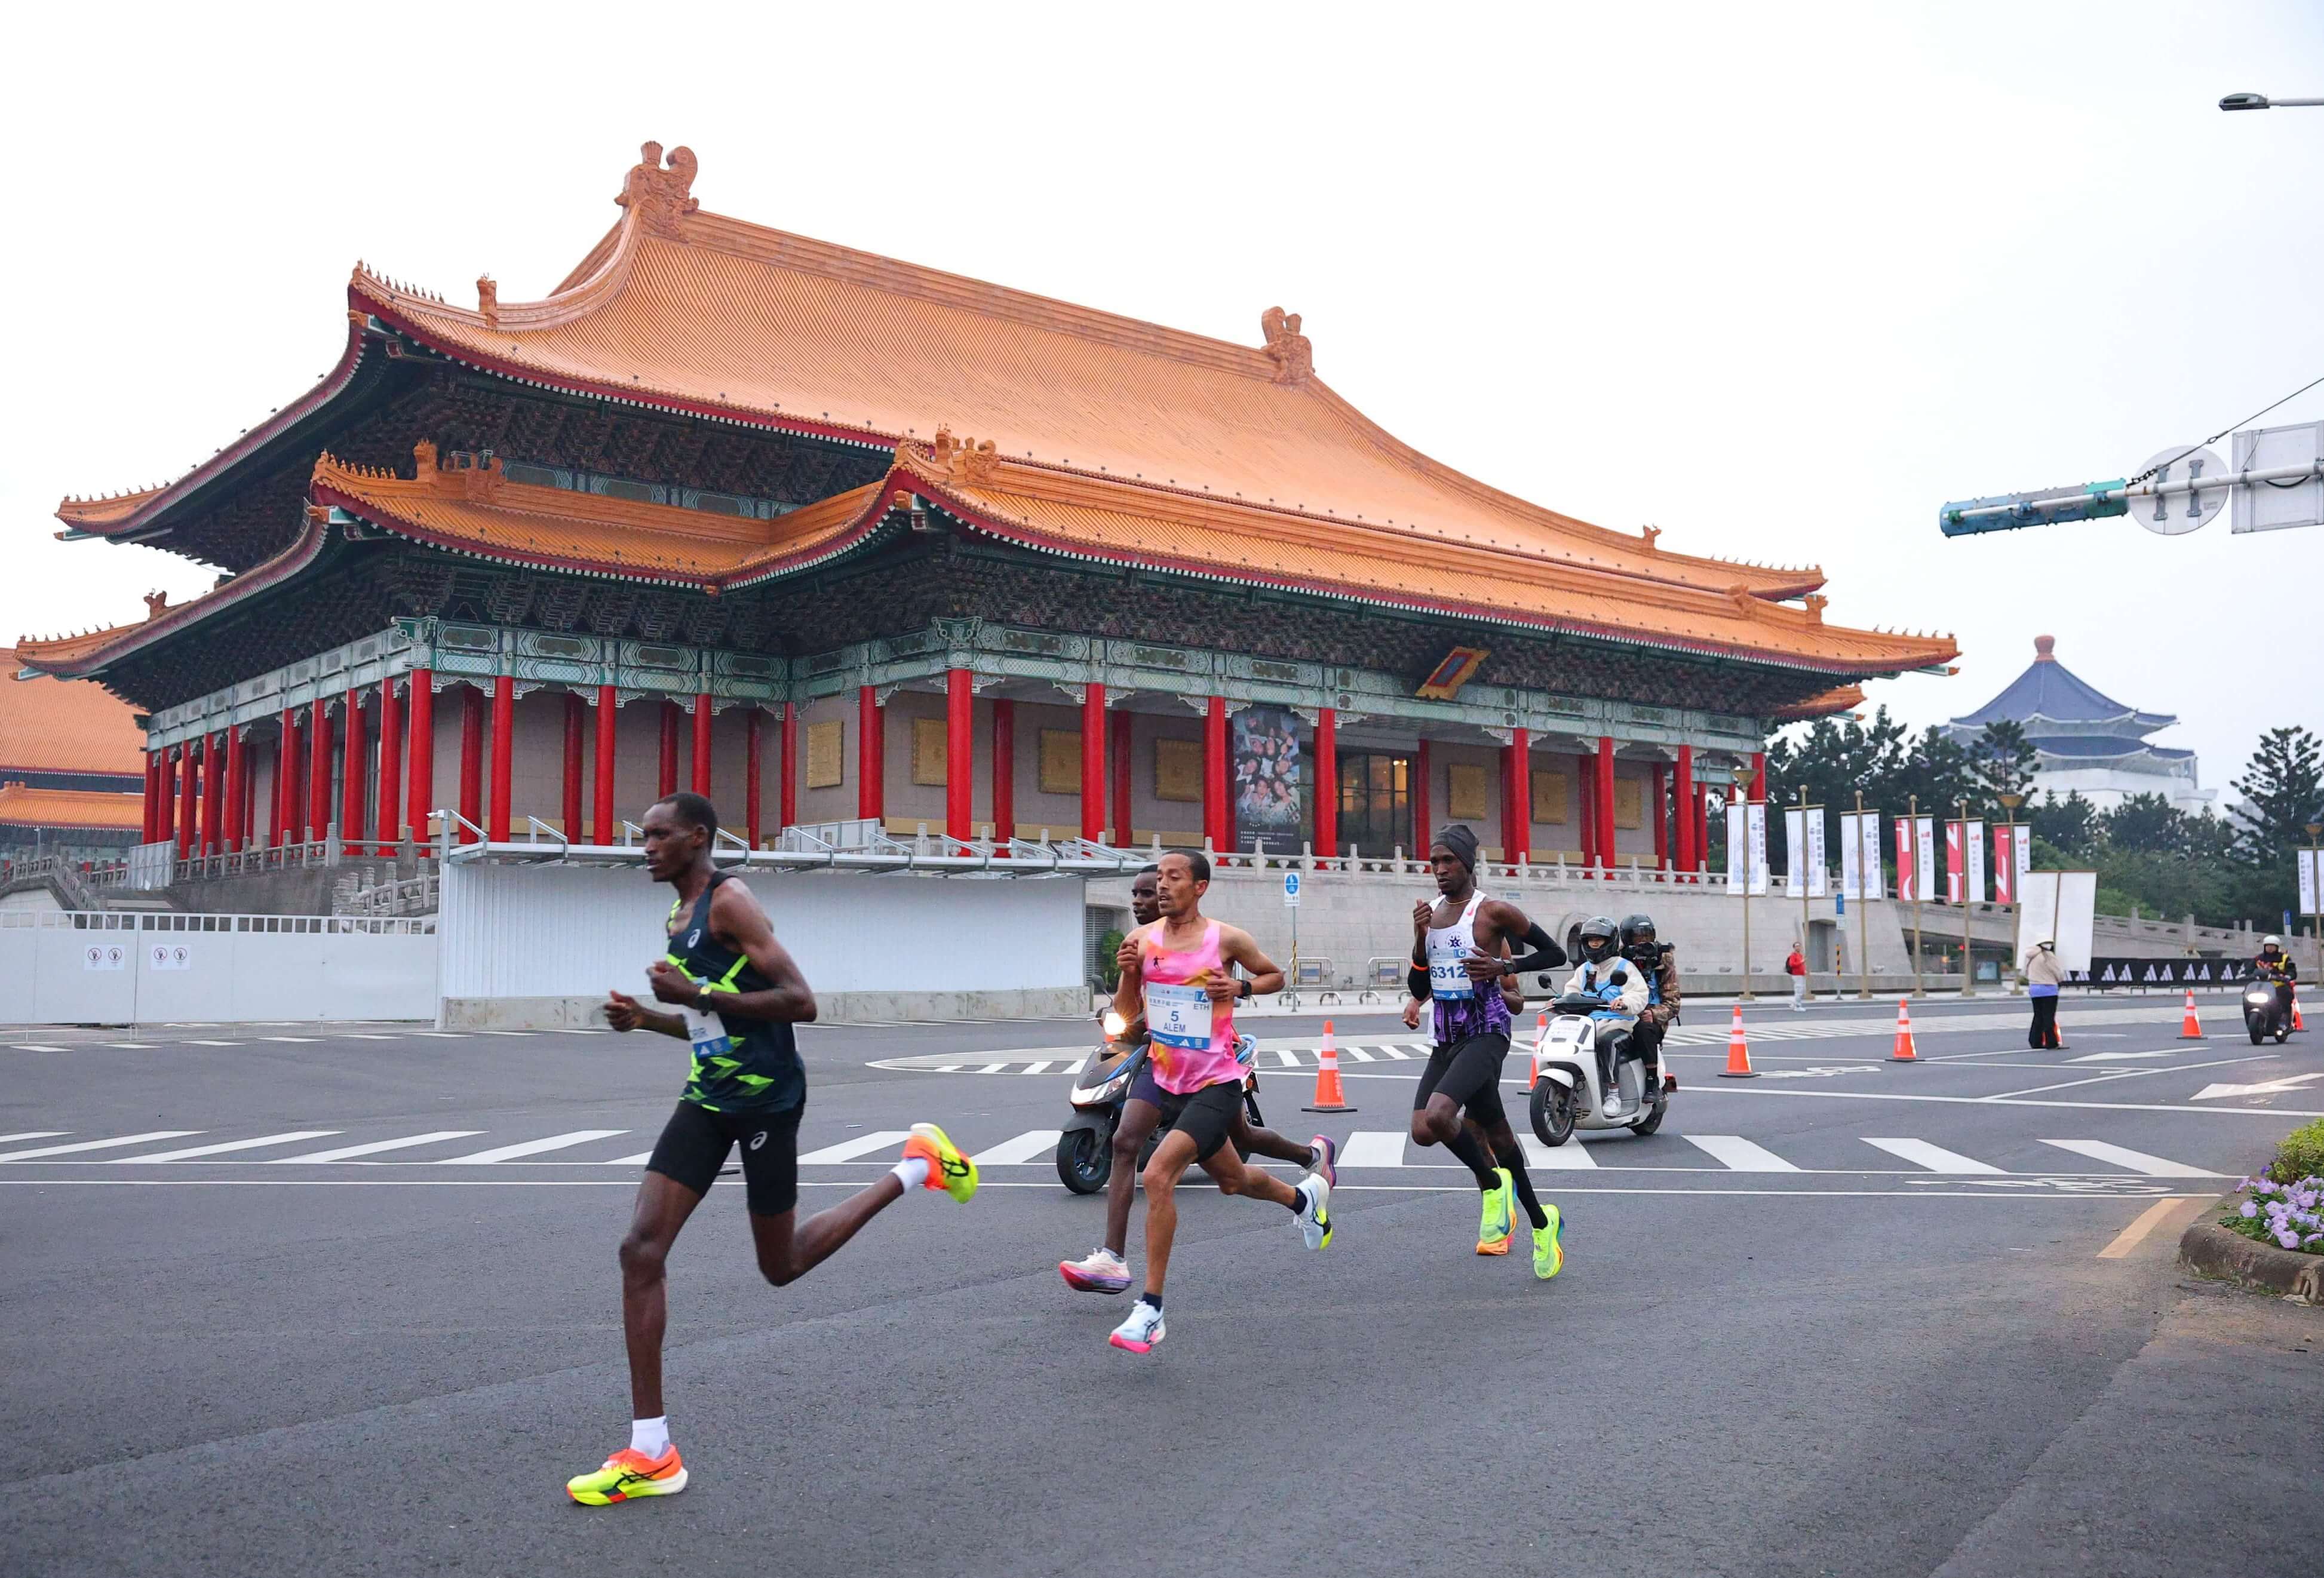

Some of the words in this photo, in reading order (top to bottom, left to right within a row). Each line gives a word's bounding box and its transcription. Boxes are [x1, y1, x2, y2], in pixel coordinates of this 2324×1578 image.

[1430, 966, 1468, 978] 6312
[1171, 1011, 1179, 1022] 5
[1163, 1023, 1186, 1033] ALEM
